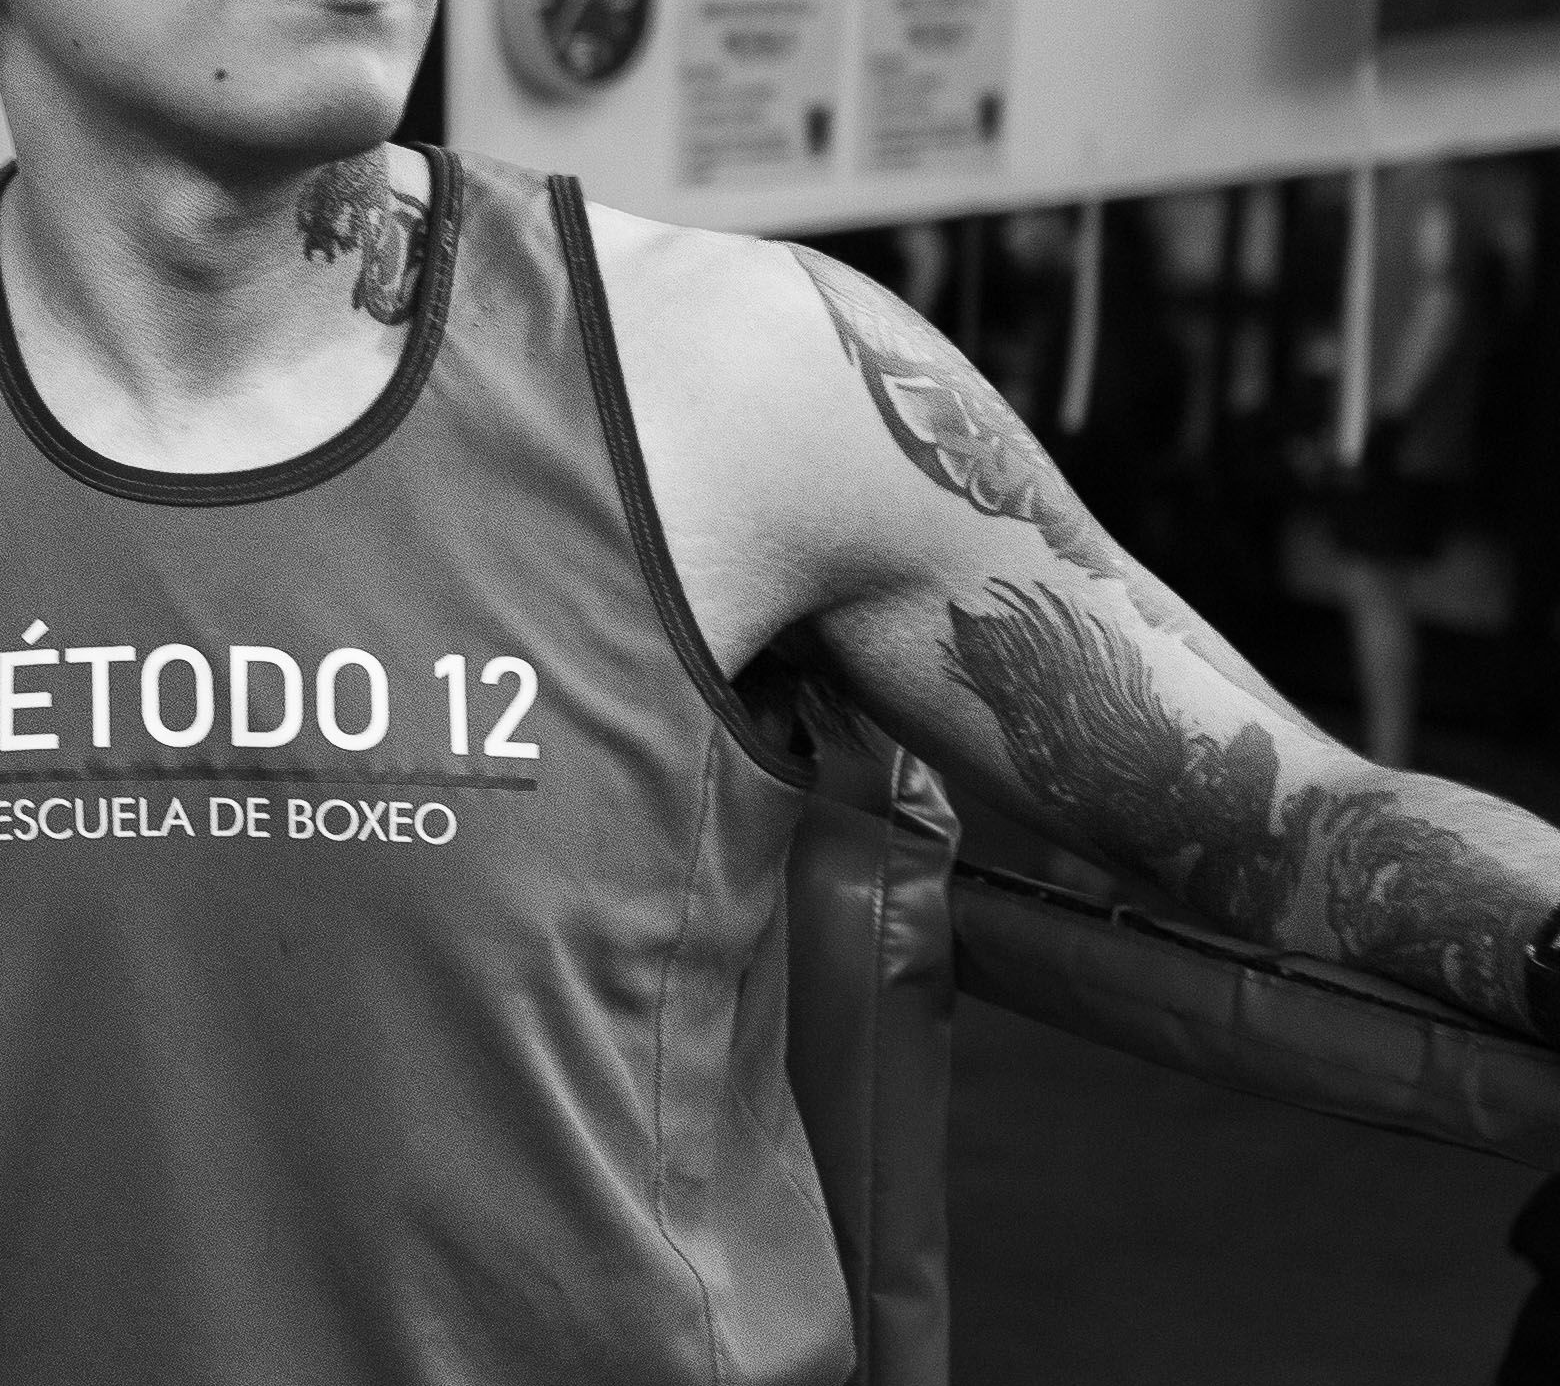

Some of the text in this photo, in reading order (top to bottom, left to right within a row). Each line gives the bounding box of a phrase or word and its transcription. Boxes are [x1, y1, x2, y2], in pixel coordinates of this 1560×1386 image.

[433, 653, 540, 760] 12
[209, 797, 271, 839] DE
[287, 799, 457, 845] BOXEO
